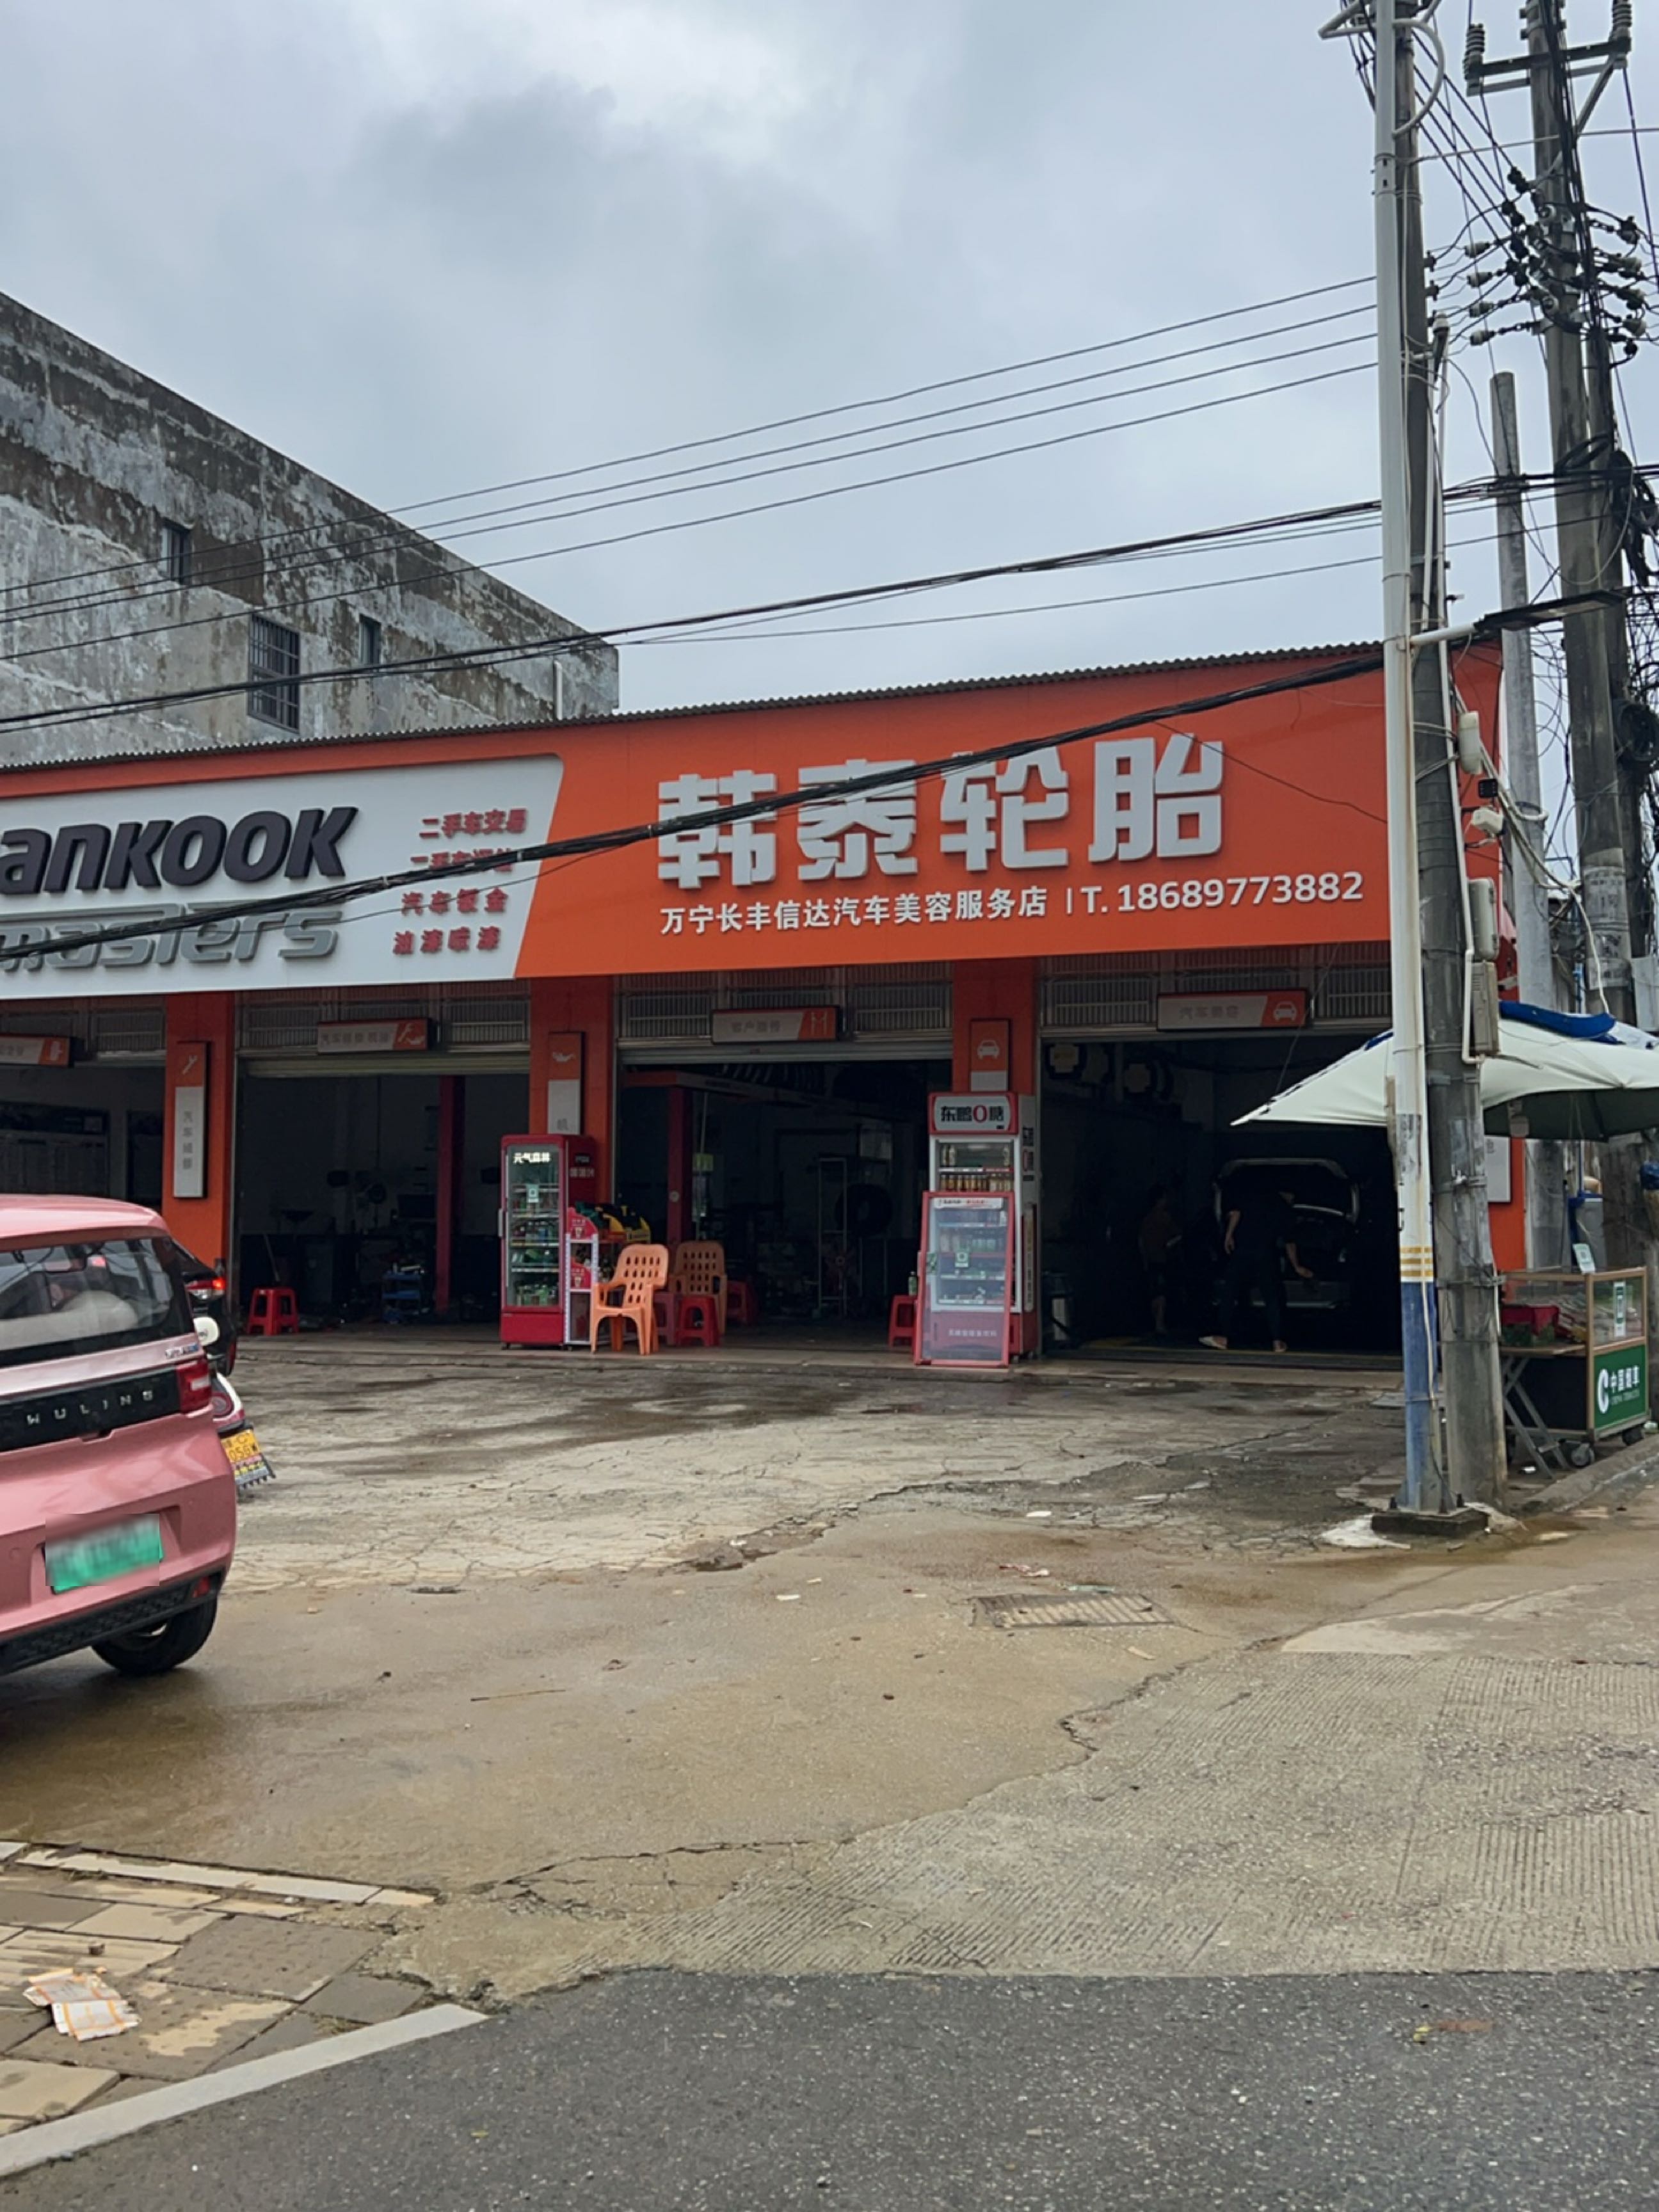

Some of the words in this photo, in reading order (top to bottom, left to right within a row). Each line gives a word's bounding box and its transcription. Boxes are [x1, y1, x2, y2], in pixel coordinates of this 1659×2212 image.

[658, 732, 1224, 890] 韩泰轮胎
[660, 886, 1047, 934] 万宁长丰信达汽车美容服务店
[1118, 872, 1363, 912] 18689773882
[26, 1390, 154, 1425] WULING
